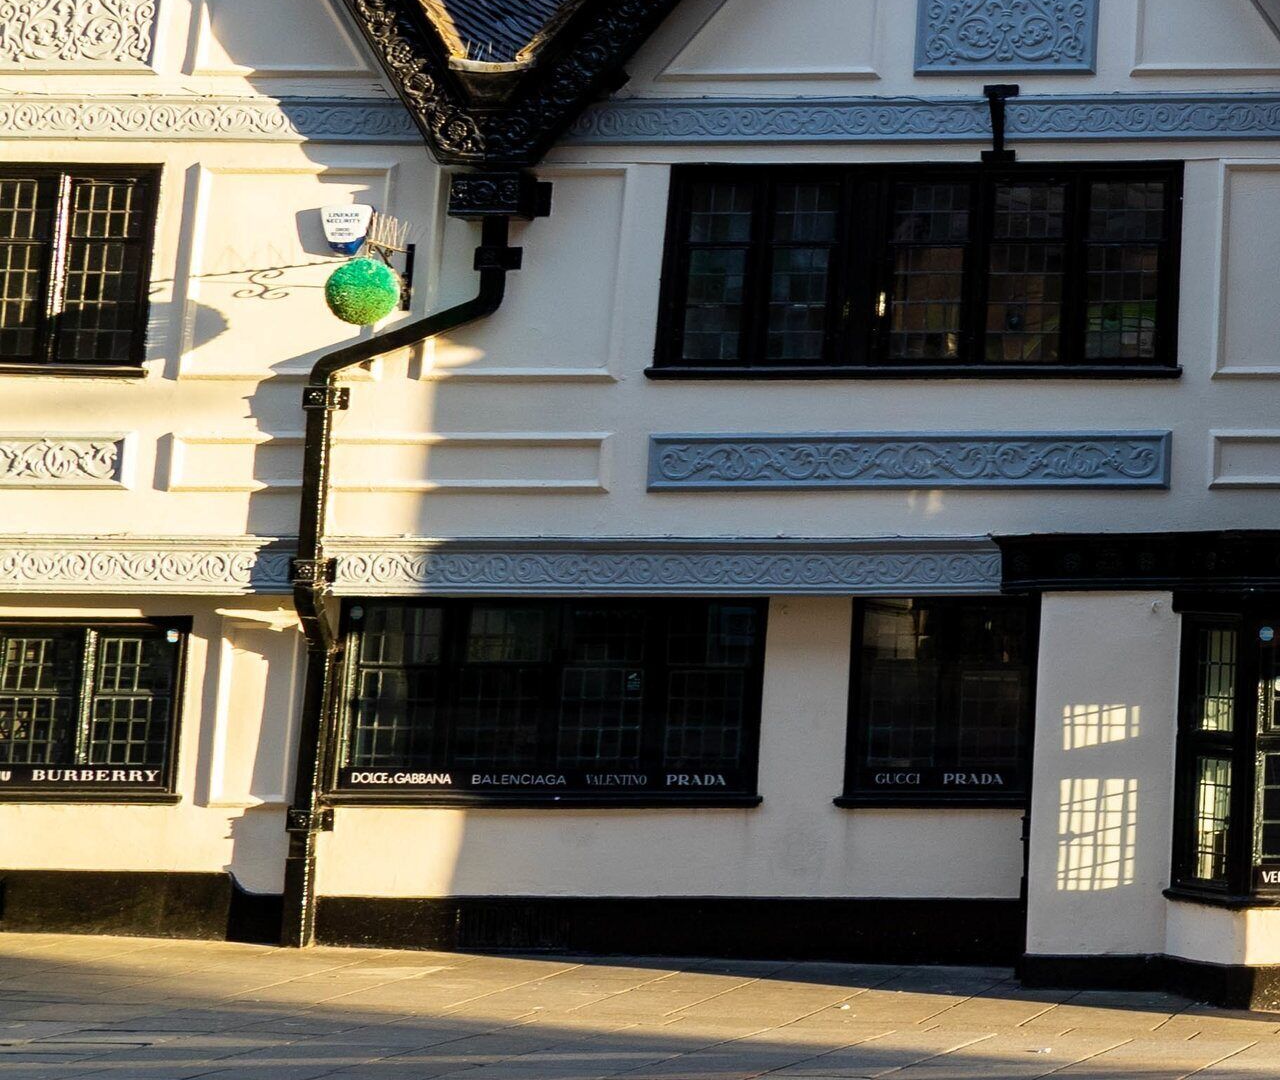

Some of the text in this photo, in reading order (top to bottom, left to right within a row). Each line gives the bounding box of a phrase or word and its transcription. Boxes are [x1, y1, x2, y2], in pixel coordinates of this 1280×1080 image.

[31, 769, 160, 782] BURBERRY
[472, 774, 567, 786] BALENCIAGA
[585, 774, 648, 786] VALENTINO
[665, 774, 727, 786] PRADA
[875, 773, 1003, 784] GUCCI PRADA
